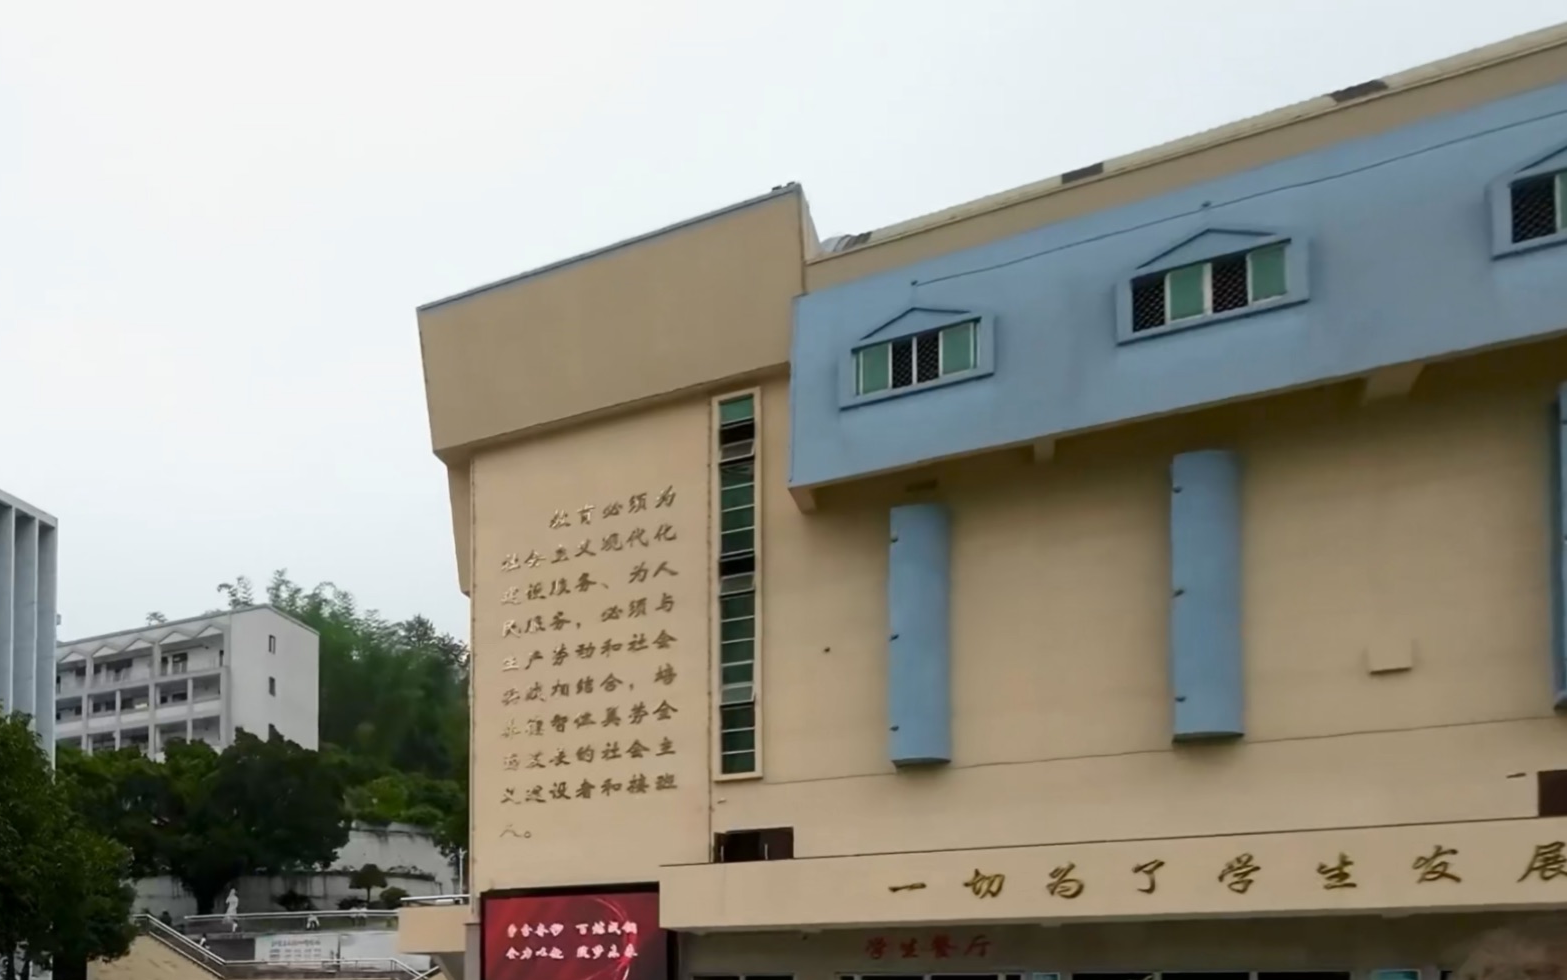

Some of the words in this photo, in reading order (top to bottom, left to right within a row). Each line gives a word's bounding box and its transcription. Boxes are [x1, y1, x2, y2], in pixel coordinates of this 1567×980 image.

[549, 485, 677, 529] 教育必须为
[501, 523, 677, 572] 社会主义现代化
[502, 629, 678, 672] 生产劳动和社会
[502, 737, 677, 771] 面发展的社会主
[500, 773, 678, 805] 义建设者和接班
[888, 841, 1567, 899] 一切为了学生发展
[864, 934, 993, 960] 学生餐厅
